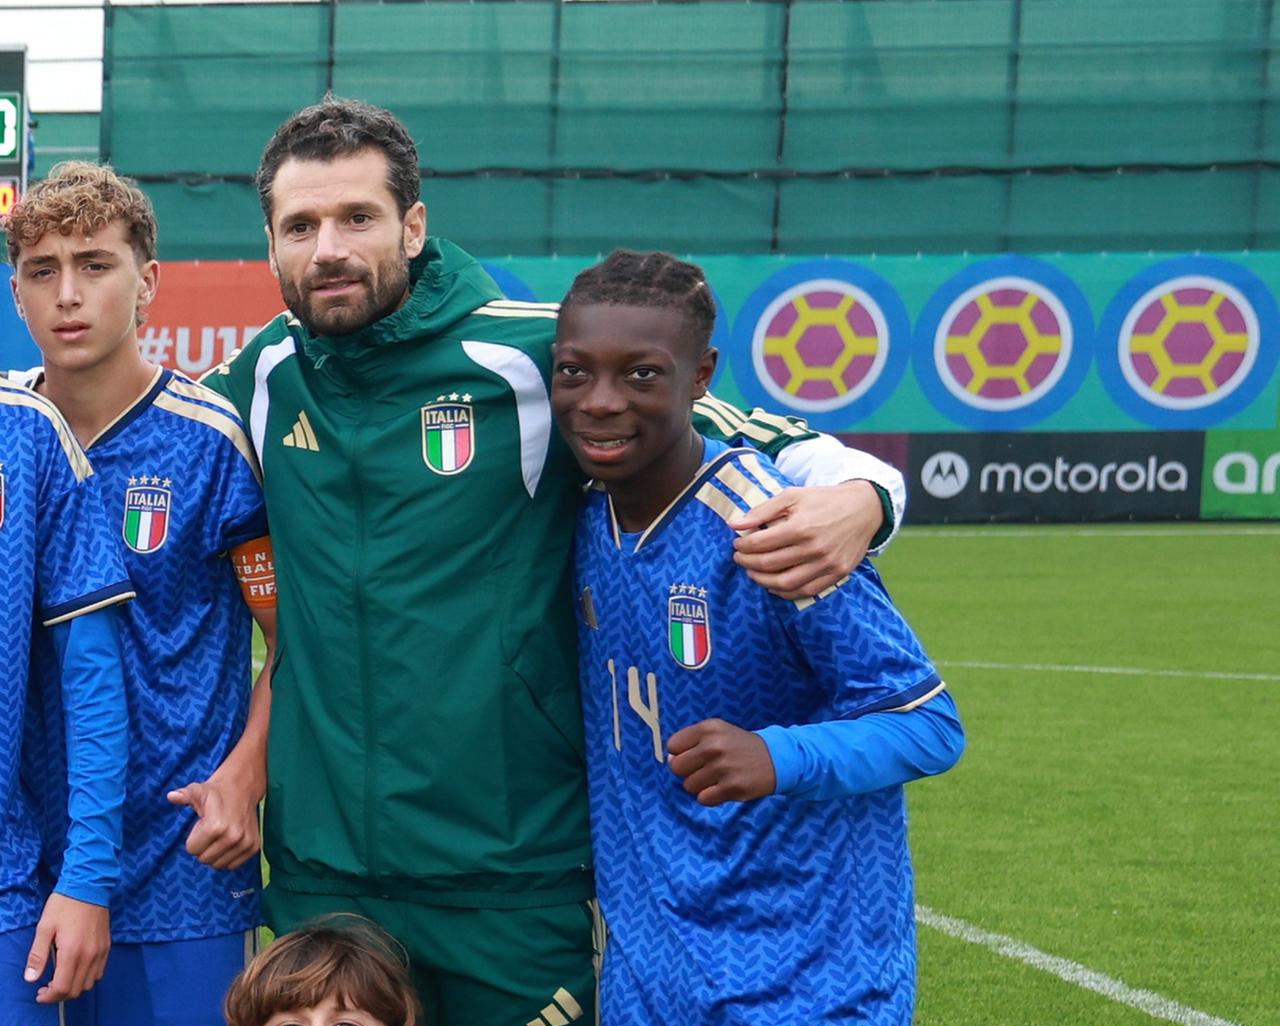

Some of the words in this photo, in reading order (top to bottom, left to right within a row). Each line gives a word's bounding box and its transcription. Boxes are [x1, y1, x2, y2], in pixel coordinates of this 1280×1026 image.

[426, 409, 469, 425] ITALIA
[980, 455, 1189, 493] motorola
[130, 492, 166, 507] ITALIA
[250, 583, 277, 596] FIF
[671, 602, 704, 618] ITALIA
[608, 659, 663, 763] 14
